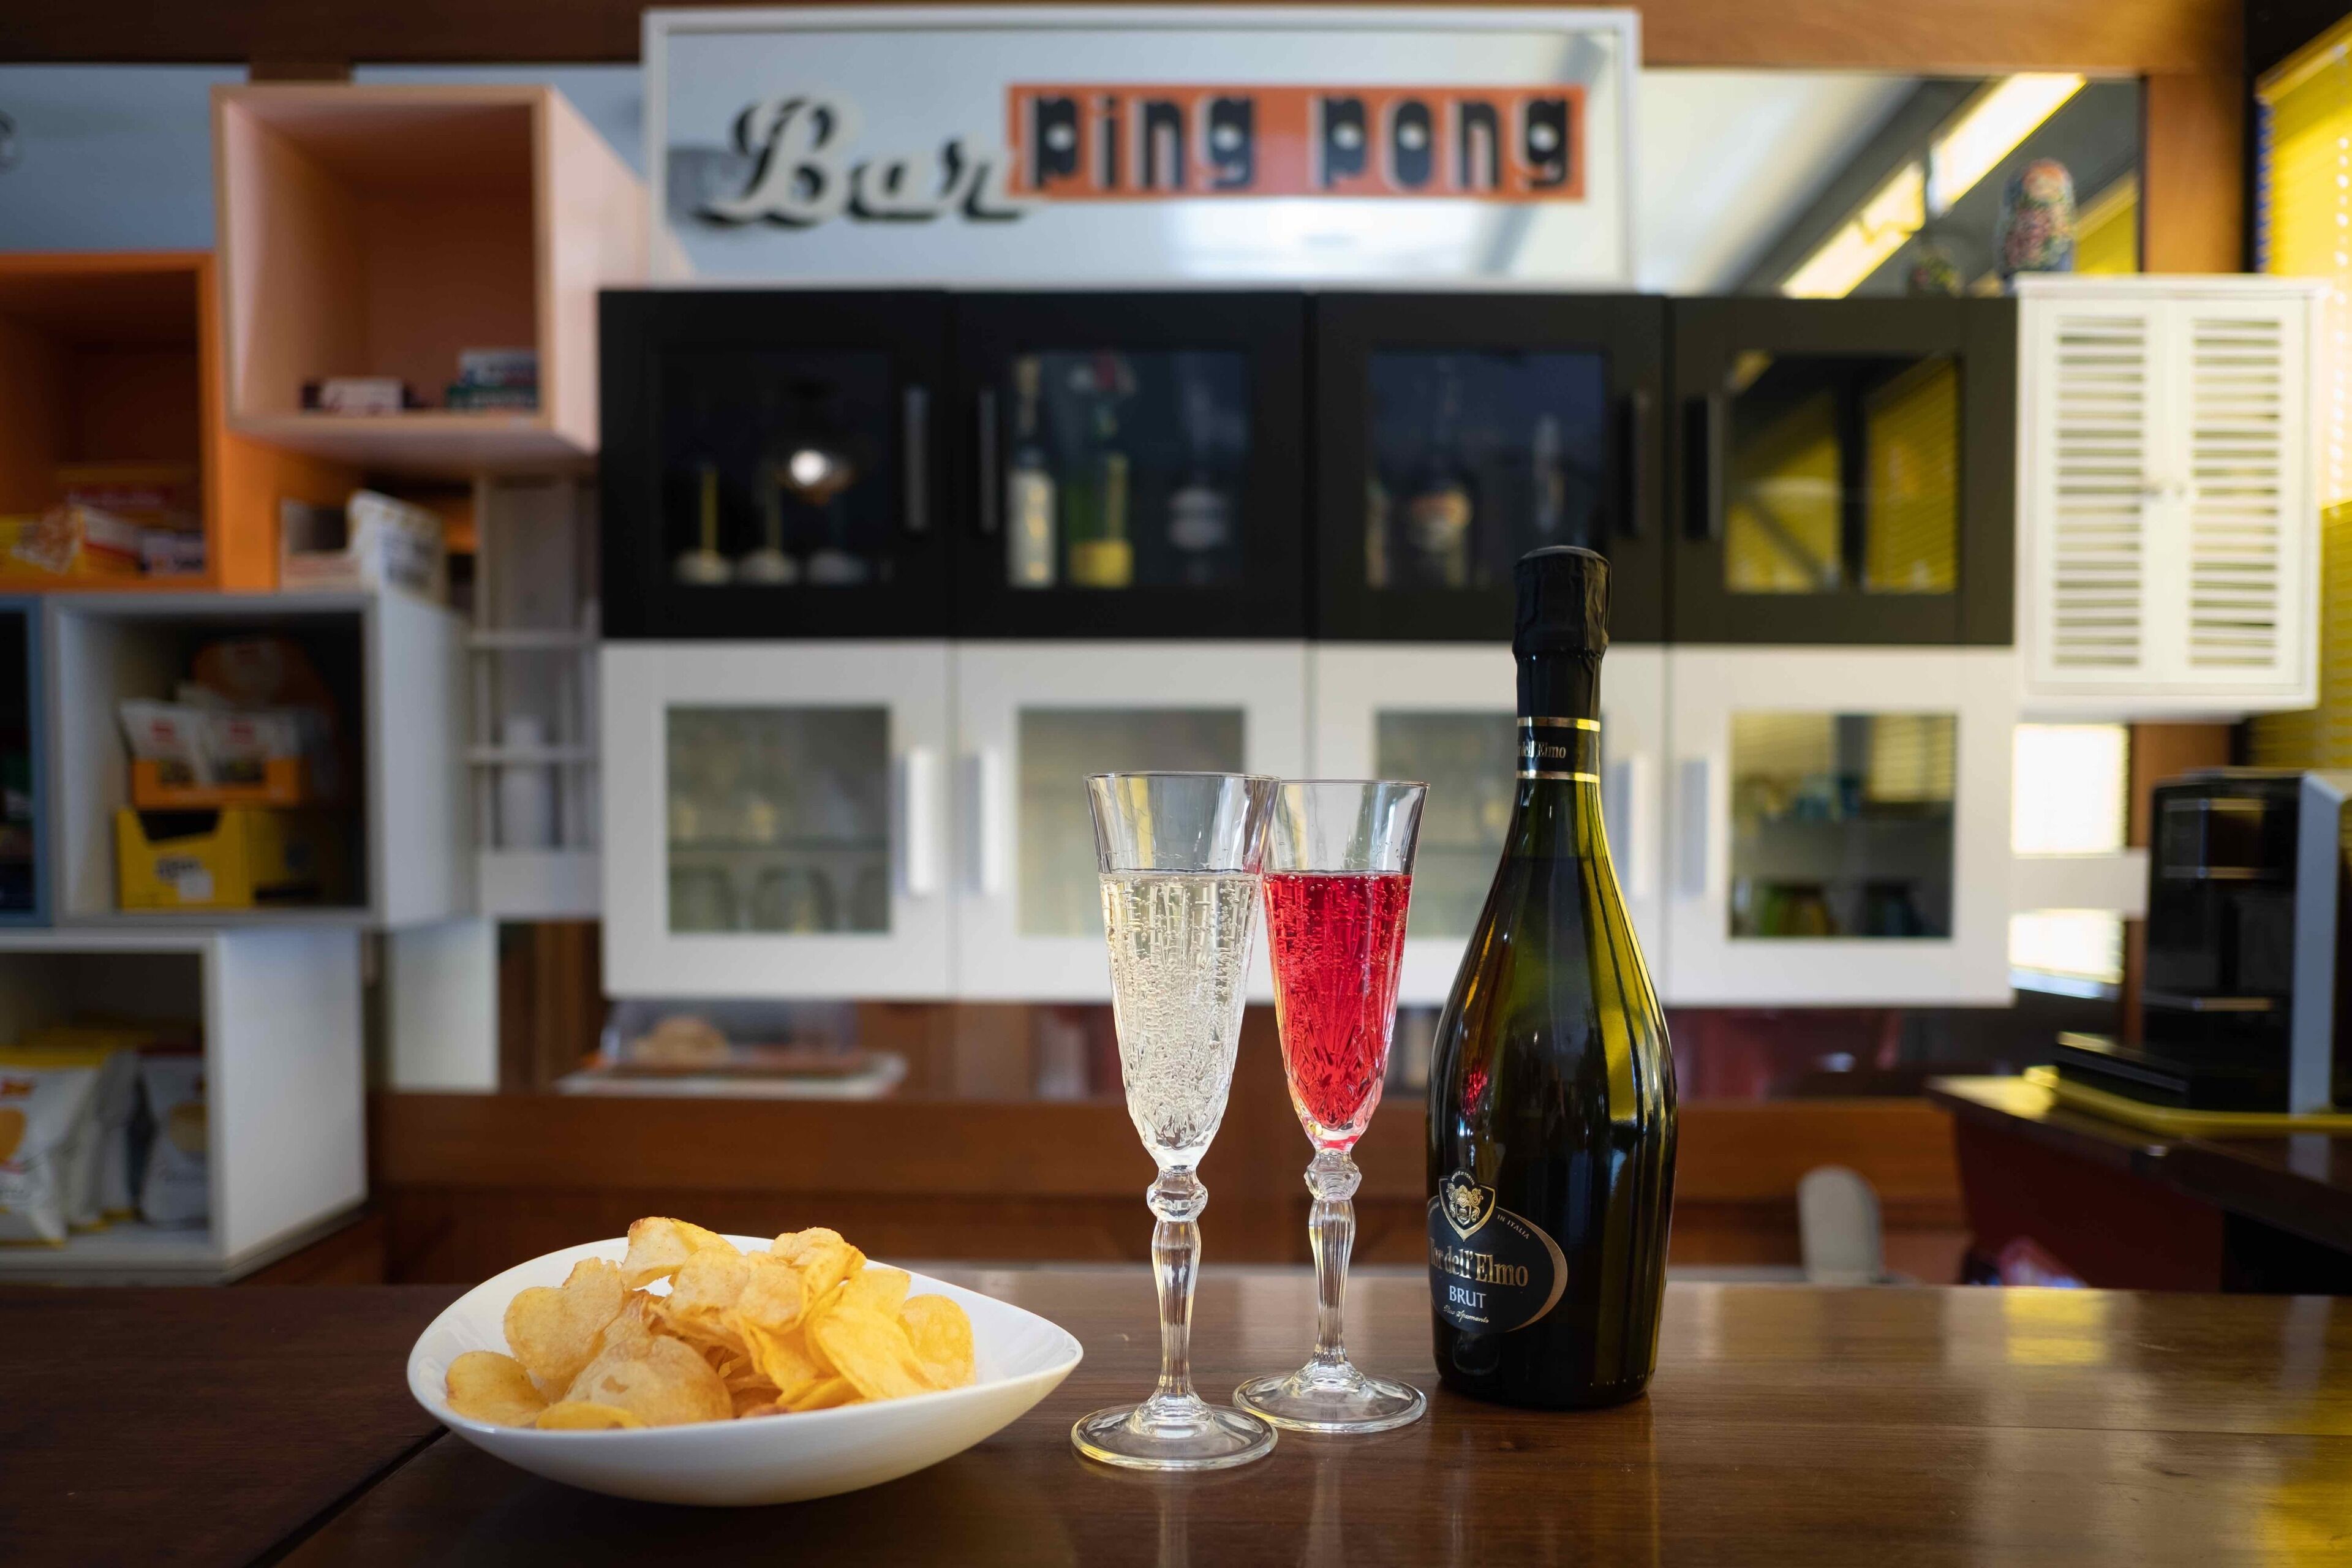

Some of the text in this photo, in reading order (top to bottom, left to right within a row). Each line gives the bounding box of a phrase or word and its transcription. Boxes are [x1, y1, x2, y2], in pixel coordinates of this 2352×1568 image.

[697, 91, 1570, 230] Bar ping pong
[1507, 1219, 1529, 1239] ITALIA
[1444, 1245, 1529, 1286] dell'Elmo
[1449, 1285, 1487, 1308] BRUT
